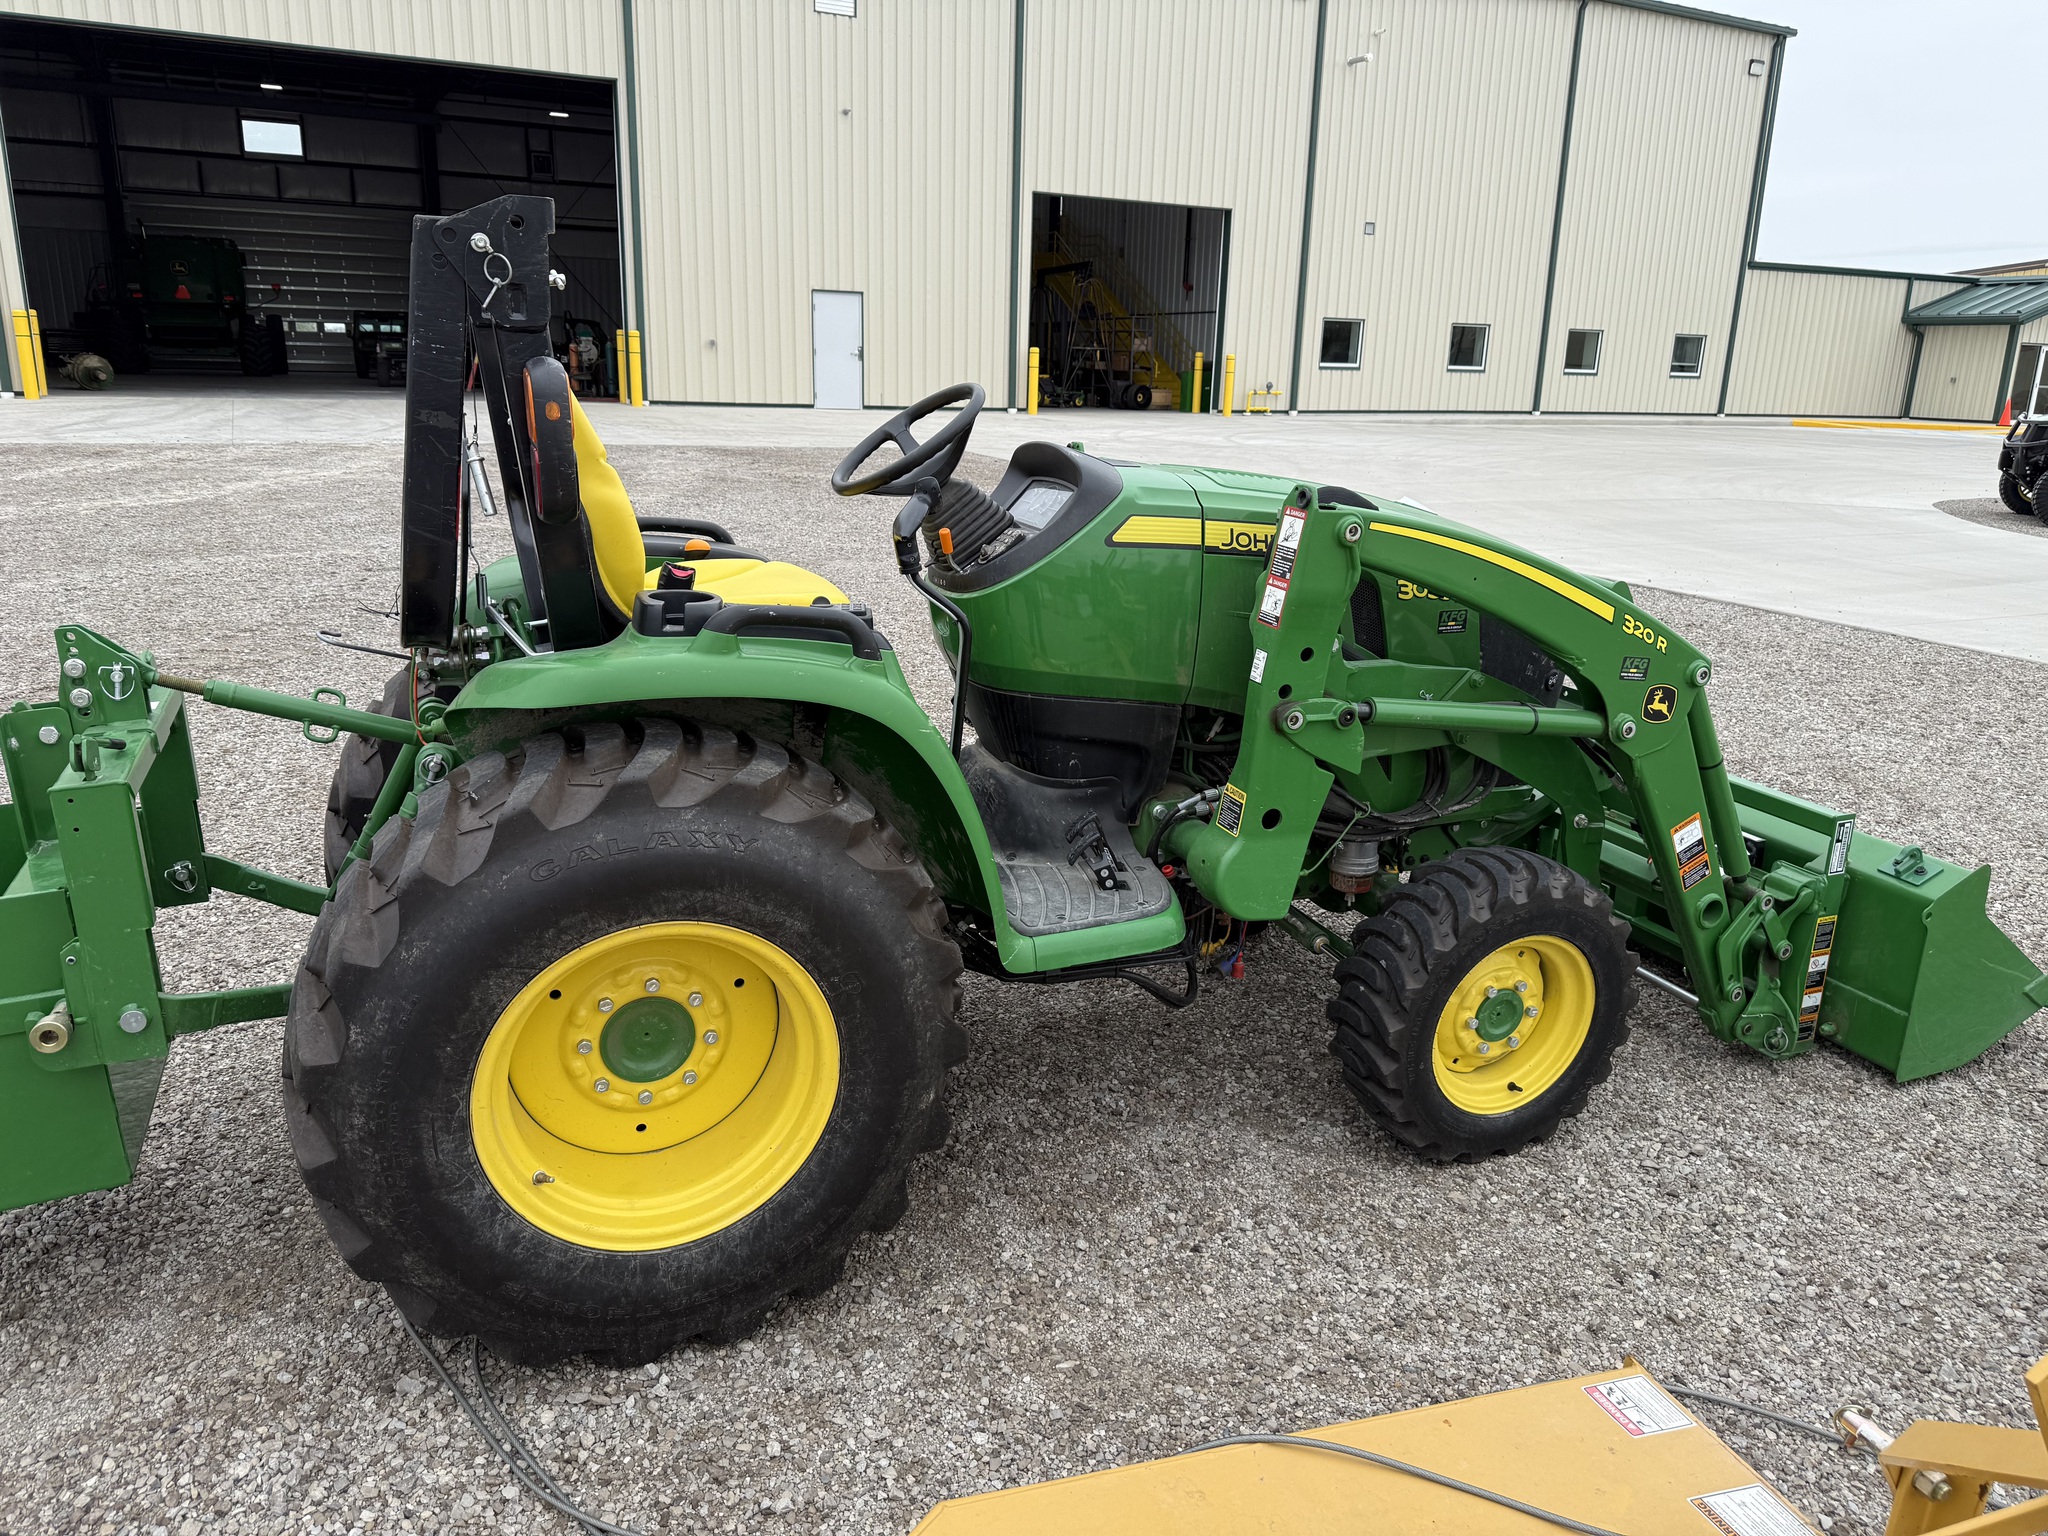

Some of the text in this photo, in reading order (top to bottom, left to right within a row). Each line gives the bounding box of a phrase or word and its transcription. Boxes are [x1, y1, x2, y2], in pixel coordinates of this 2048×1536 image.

[1290, 509, 1306, 518] DANGER
[1221, 527, 1276, 549] JOH
[1272, 579, 1288, 588] DANGER
[1397, 578, 1450, 601] 30
[1440, 610, 1466, 622] KFG
[1622, 613, 1668, 654] 320 R
[1623, 657, 1649, 669] KFG
[1229, 786, 1245, 800] CAUTION
[1678, 816, 1697, 830] WARNING
[528, 830, 759, 883] GALAXY
[1687, 857, 1706, 870] WARNING
[1592, 1391, 1628, 1424] DANGER
[1697, 1501, 1738, 1536] RNING
